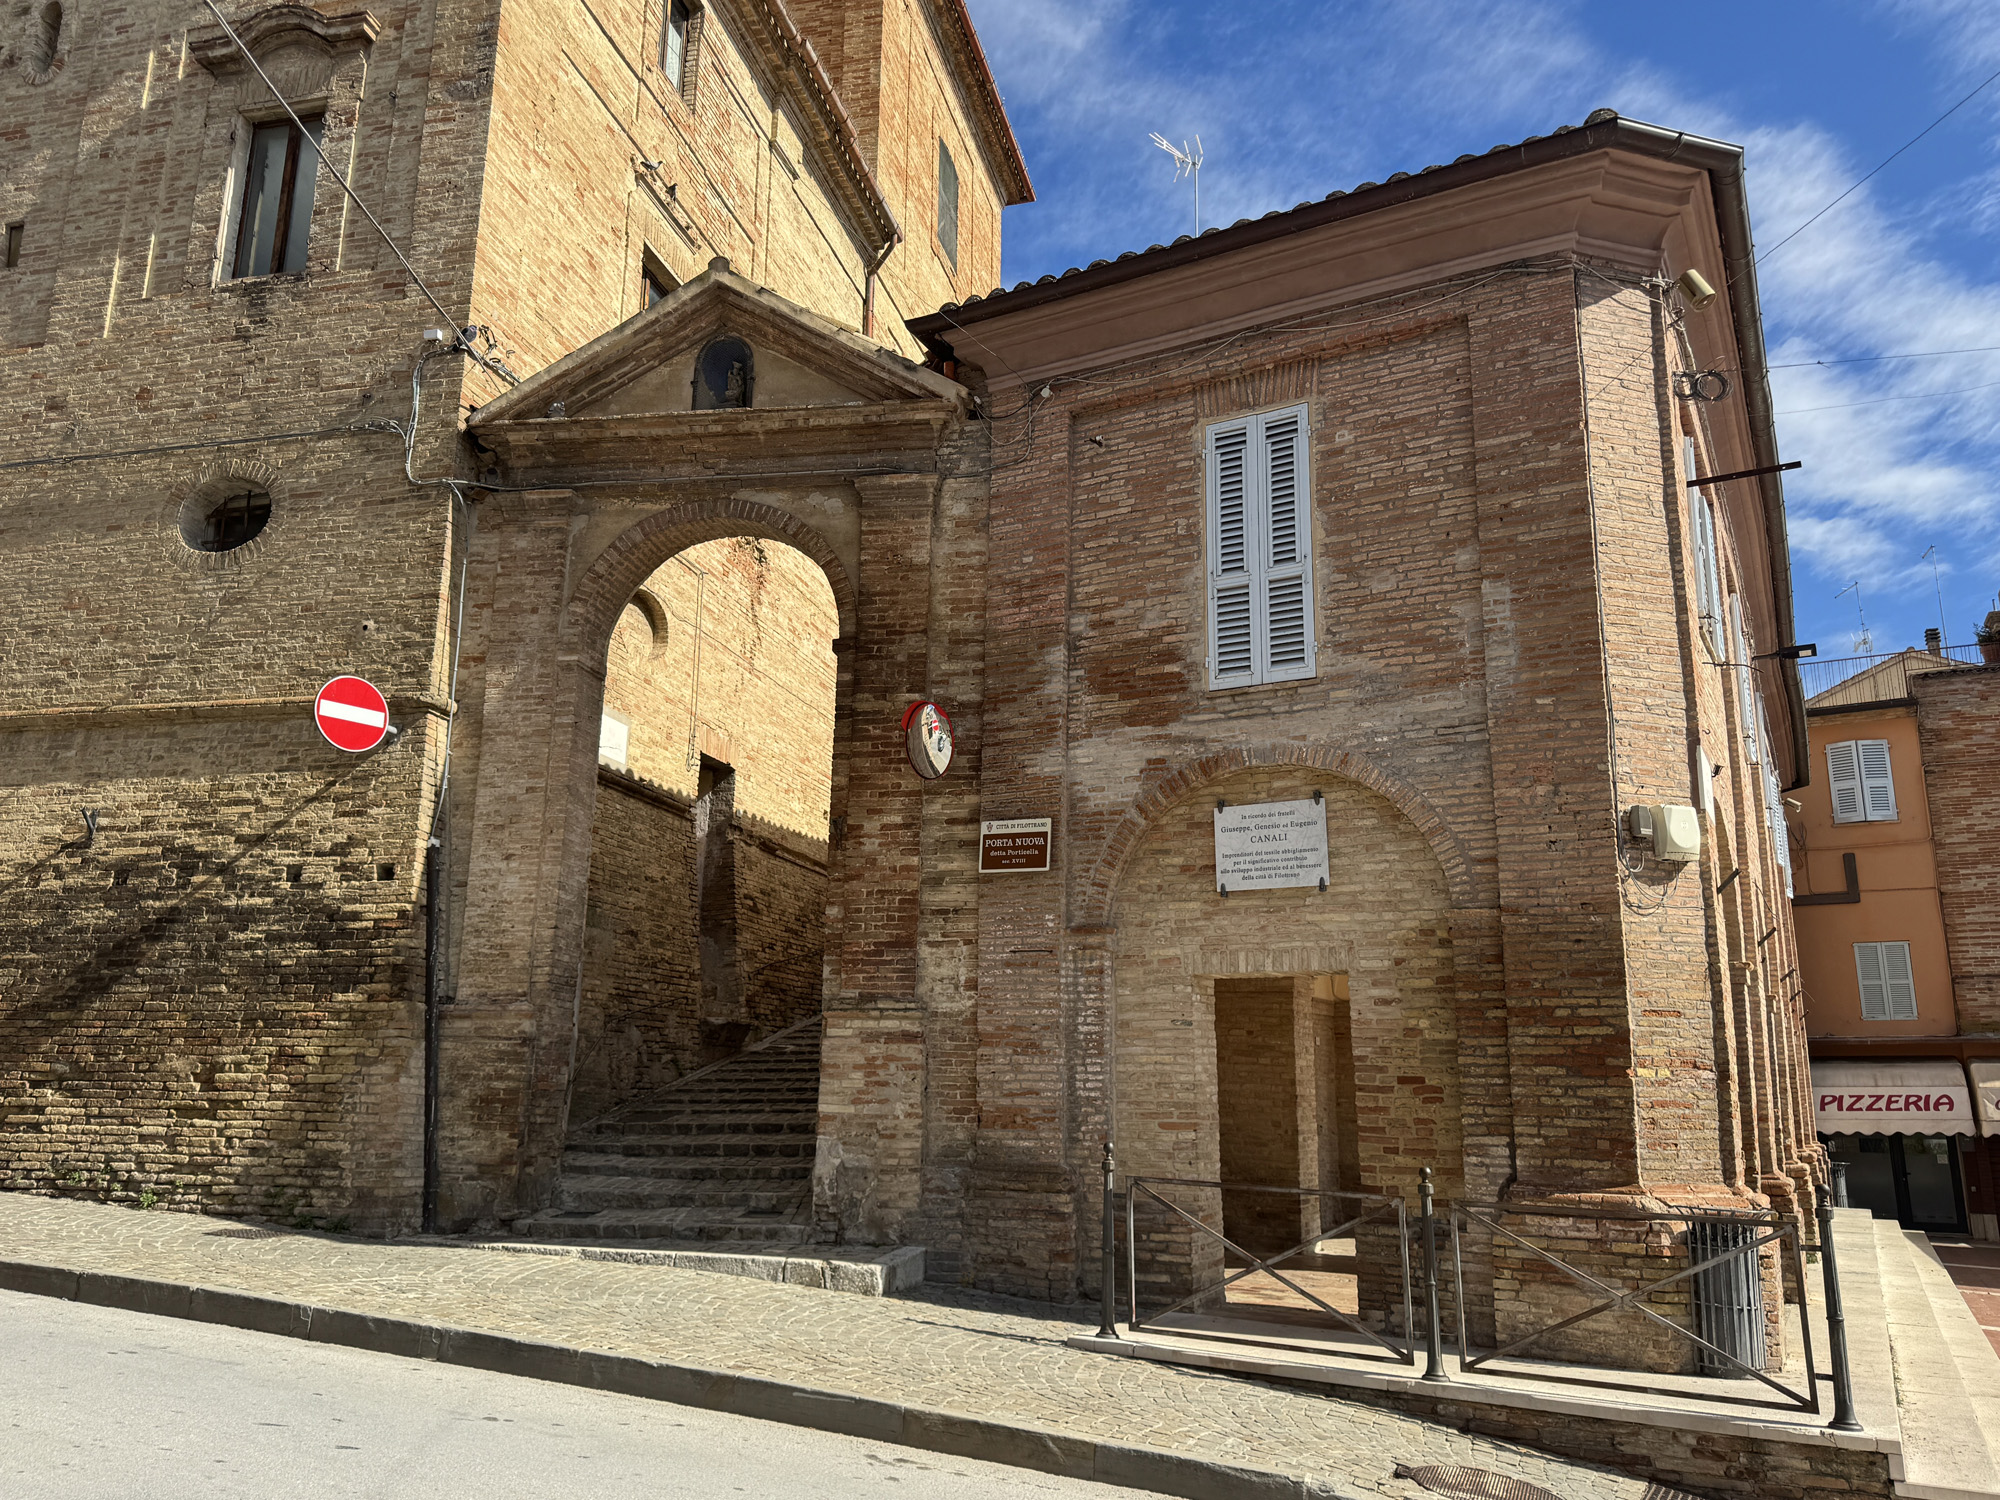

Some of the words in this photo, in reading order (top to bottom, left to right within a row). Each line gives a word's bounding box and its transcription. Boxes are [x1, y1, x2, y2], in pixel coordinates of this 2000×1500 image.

[1220, 825, 1253, 833] Giuseppe,
[1254, 823, 1280, 831] Genesio
[1290, 820, 1318, 828] Eugenio
[985, 838, 1014, 848] PORTA
[1015, 837, 1045, 846] NUOVA
[1250, 833, 1288, 844] CANALI
[1222, 851, 1254, 859] Imprenditori
[1281, 847, 1319, 855] abbigliamento
[1248, 857, 1280, 866] significativo
[1231, 866, 1253, 874] sviluppo
[1819, 1094, 1955, 1112] PIZZERIA
